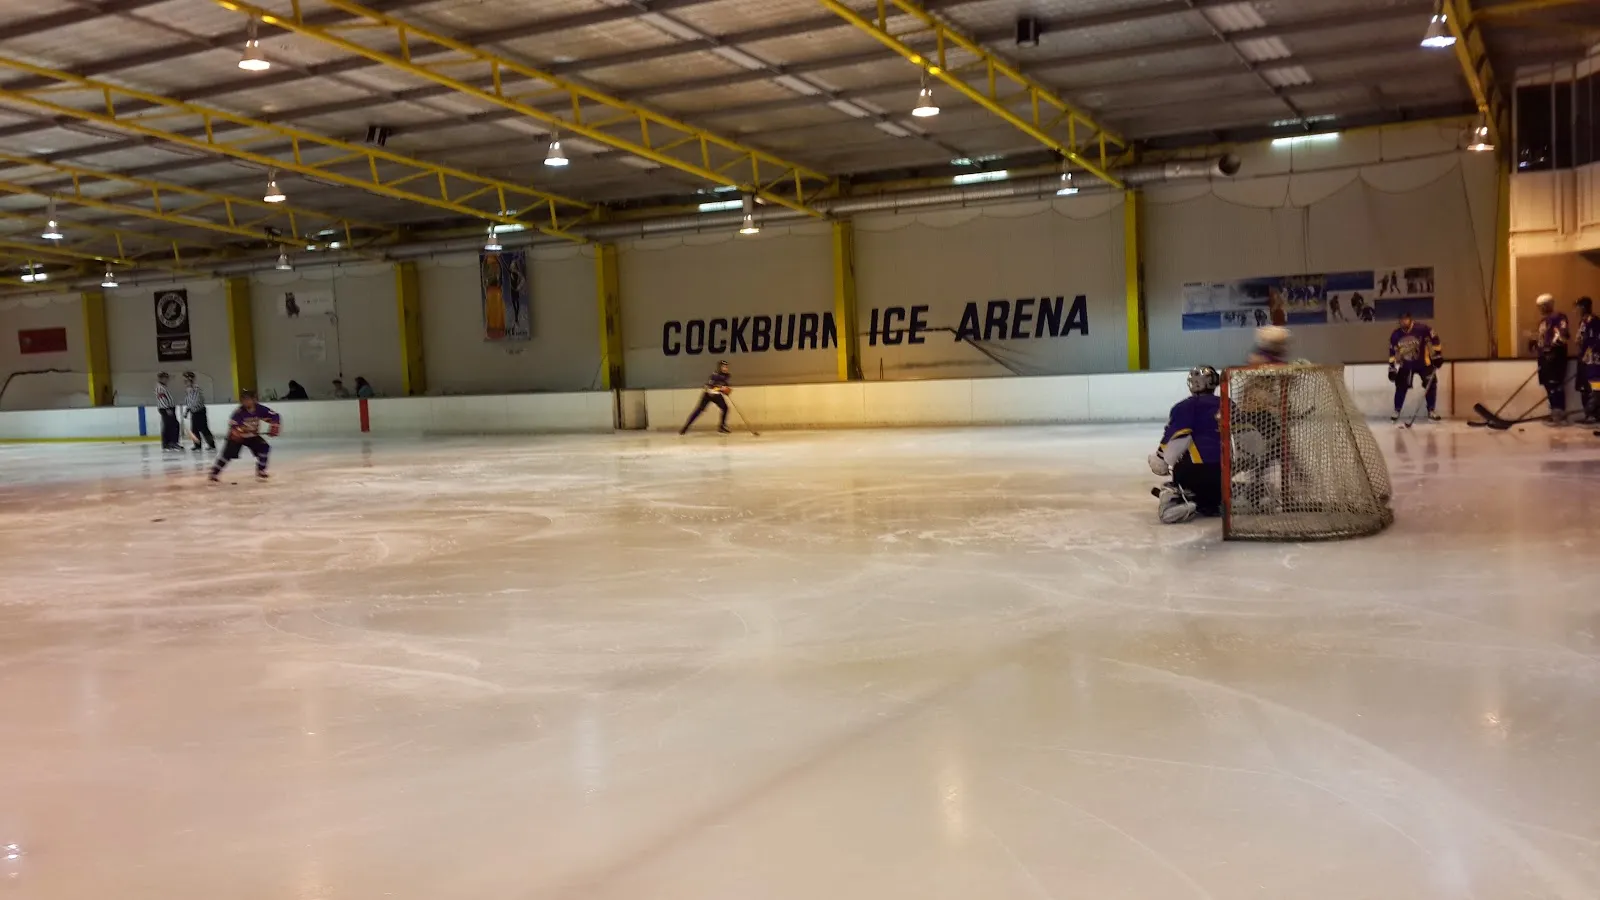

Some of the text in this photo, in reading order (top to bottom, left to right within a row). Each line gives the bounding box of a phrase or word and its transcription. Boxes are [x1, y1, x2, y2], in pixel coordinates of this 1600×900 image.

[663, 295, 1089, 356] COCKBURN ICE ARENA
